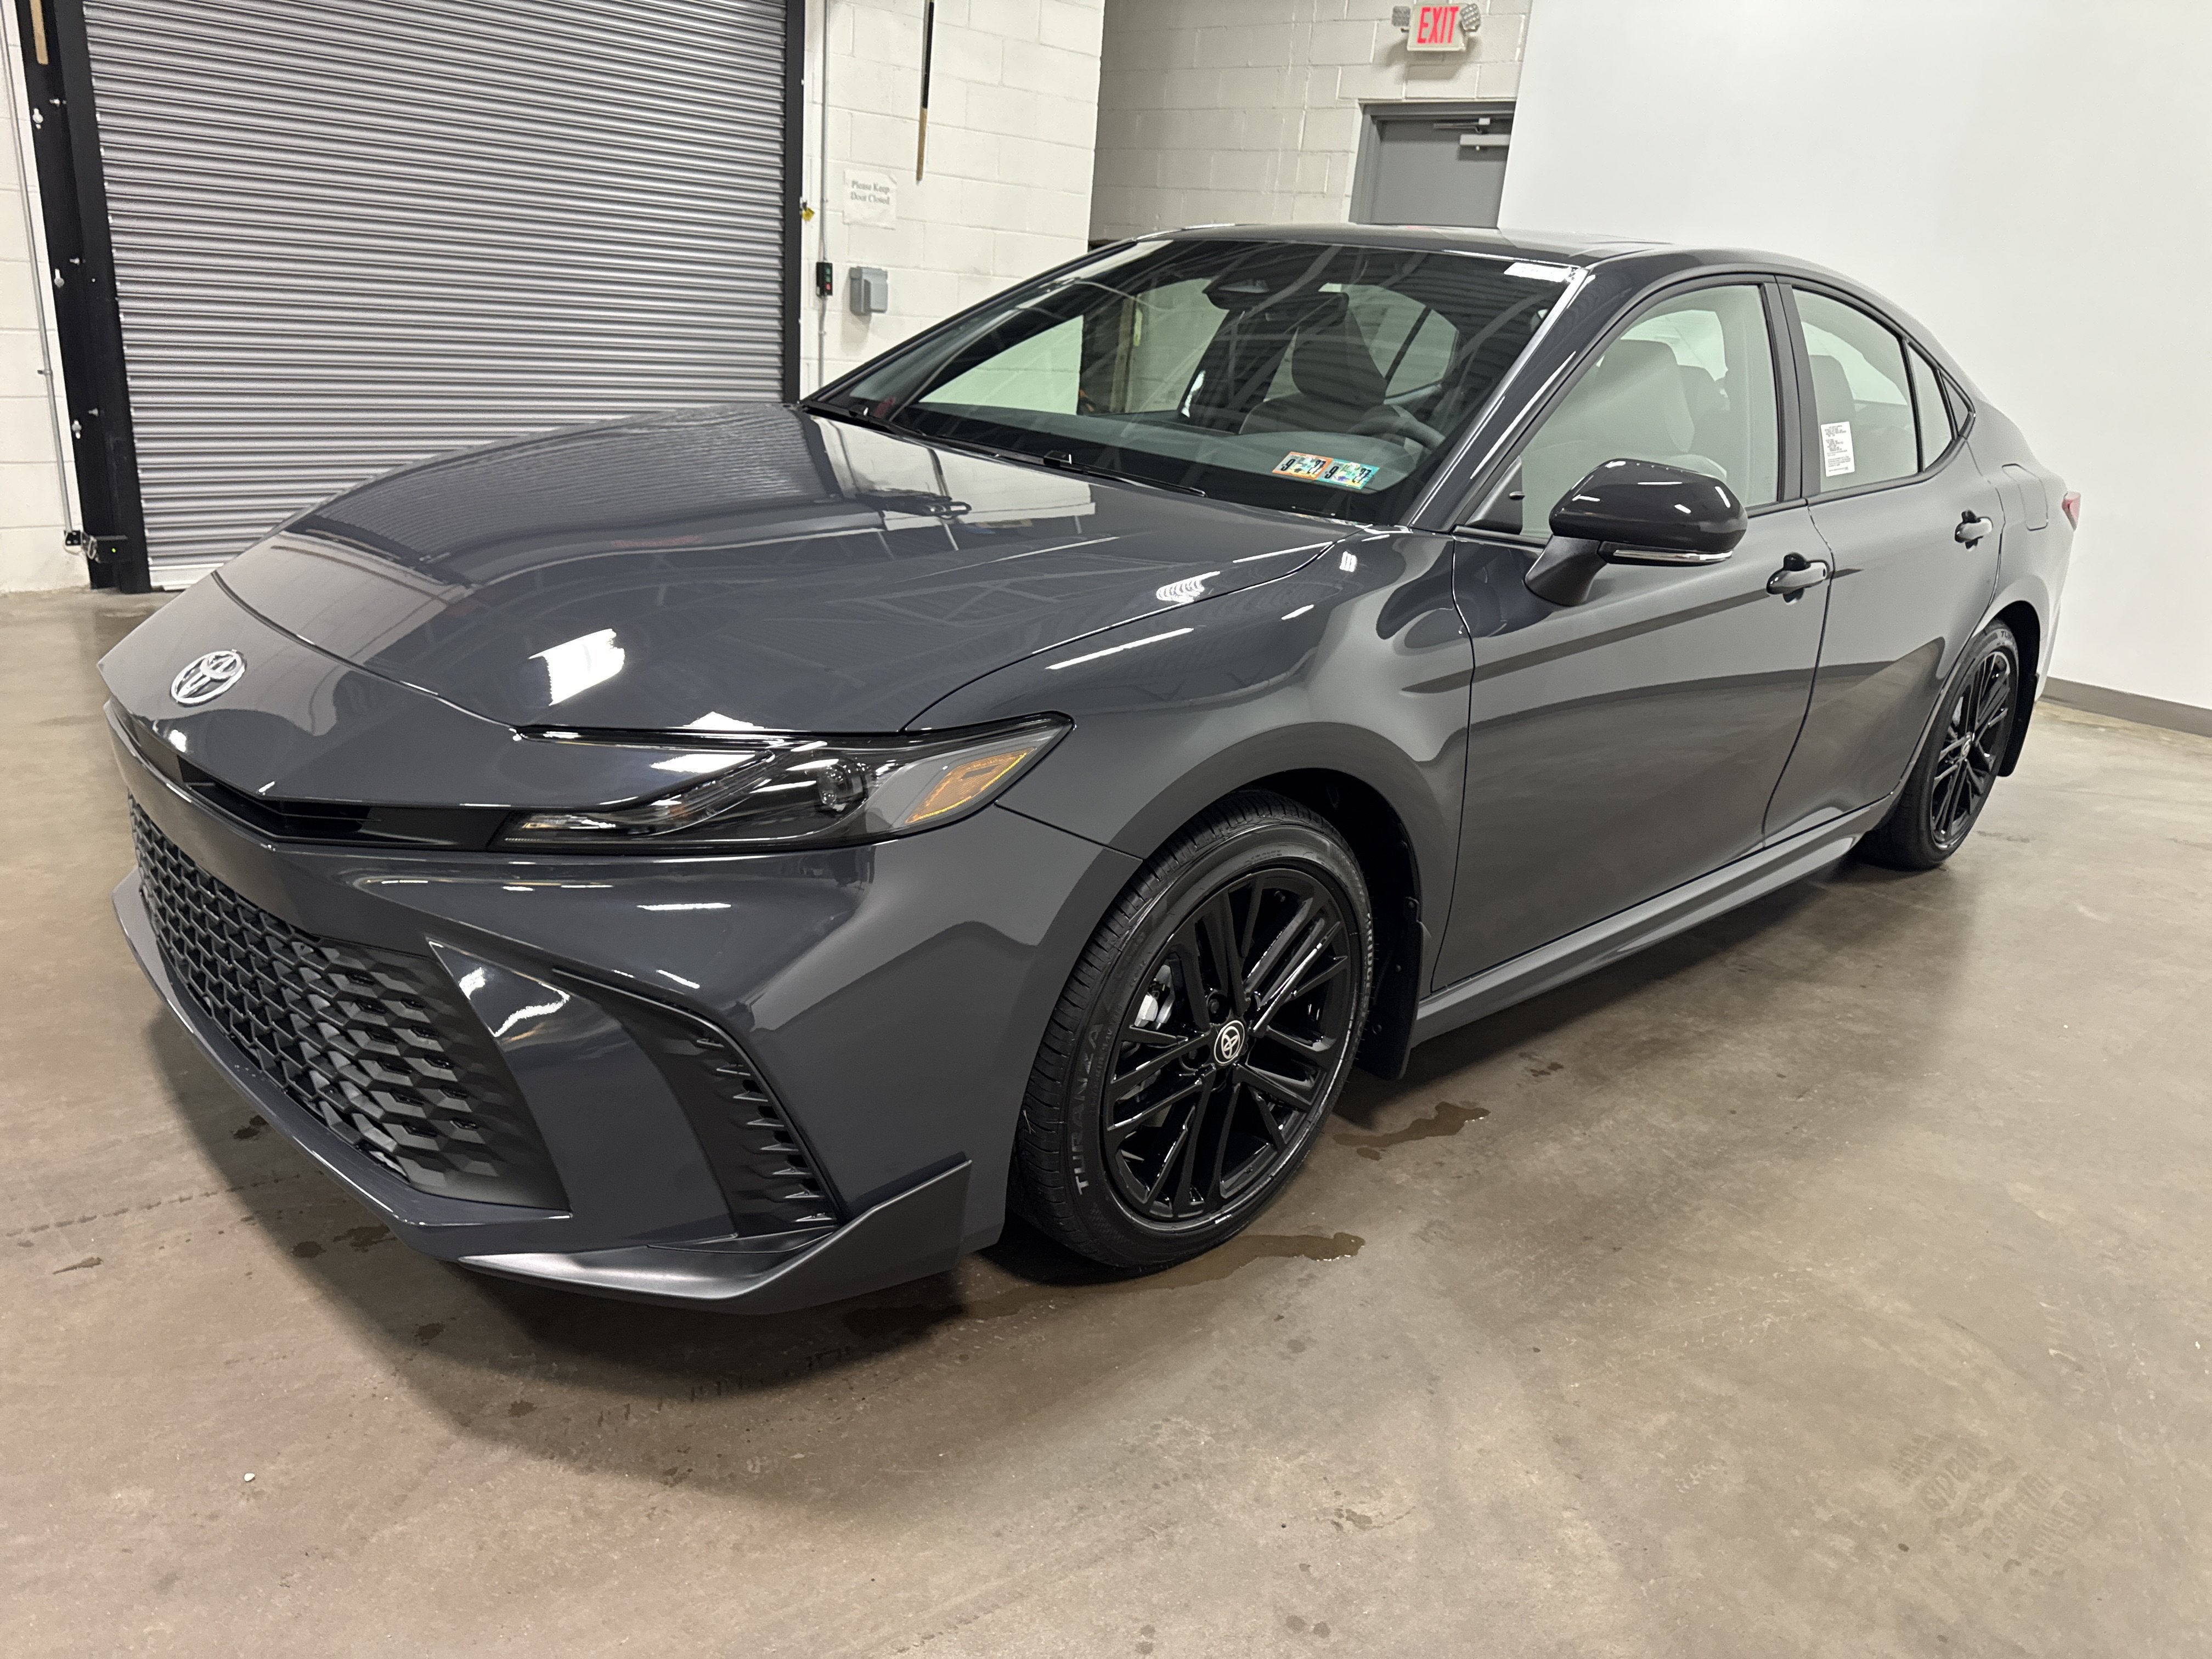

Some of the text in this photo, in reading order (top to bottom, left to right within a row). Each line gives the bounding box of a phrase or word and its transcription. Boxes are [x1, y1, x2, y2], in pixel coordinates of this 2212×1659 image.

[1417, 7, 1459, 44] EXIT
[851, 180, 872, 190] Please
[1280, 459, 1296, 471] 9
[1324, 466, 1339, 479] 9
[1071, 1023, 1104, 1195] TURANZA
